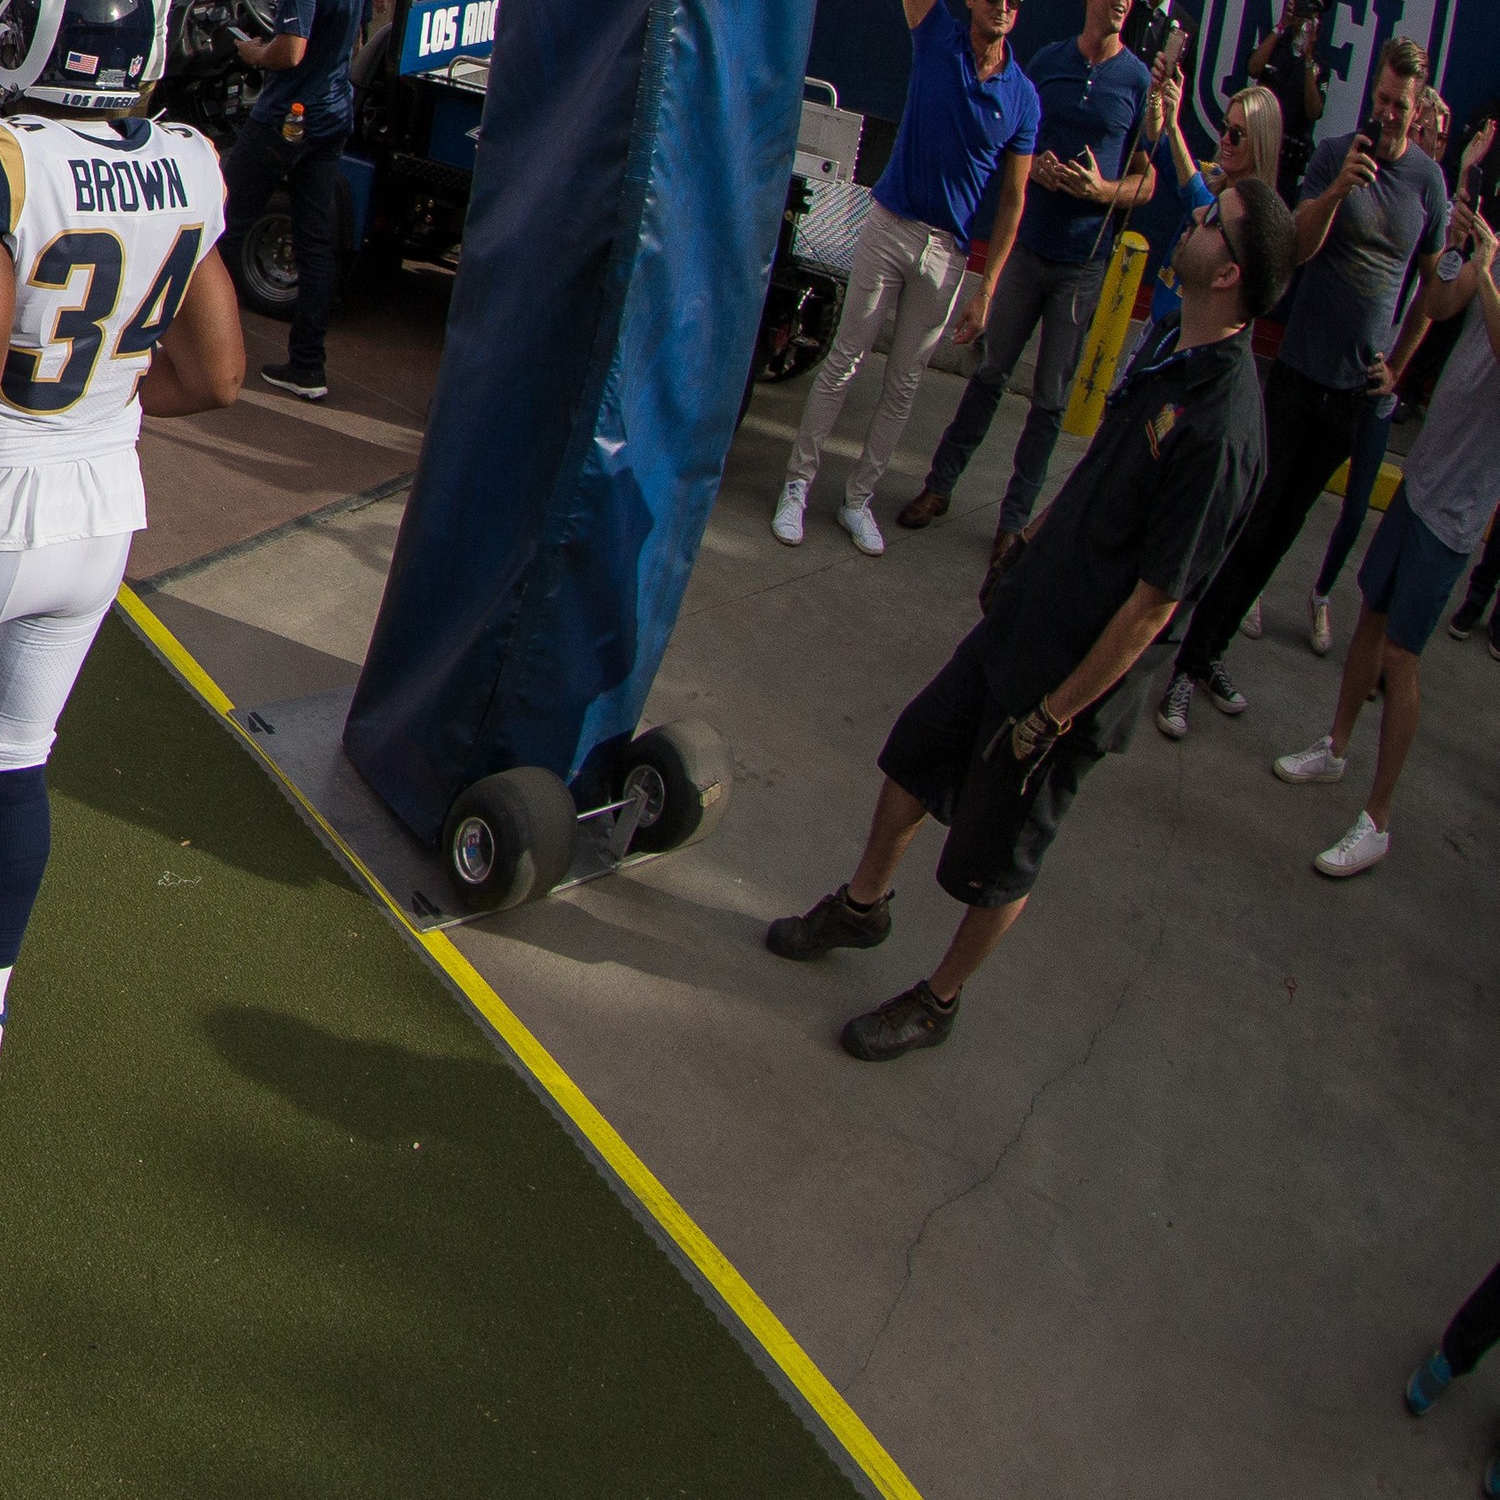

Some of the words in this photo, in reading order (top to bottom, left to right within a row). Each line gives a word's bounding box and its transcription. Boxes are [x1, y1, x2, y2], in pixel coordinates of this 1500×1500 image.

[419, 6, 460, 57] LOS
[61, 93, 93, 106] LOS
[67, 157, 188, 214] BROWN
[0, 221, 205, 416] 34
